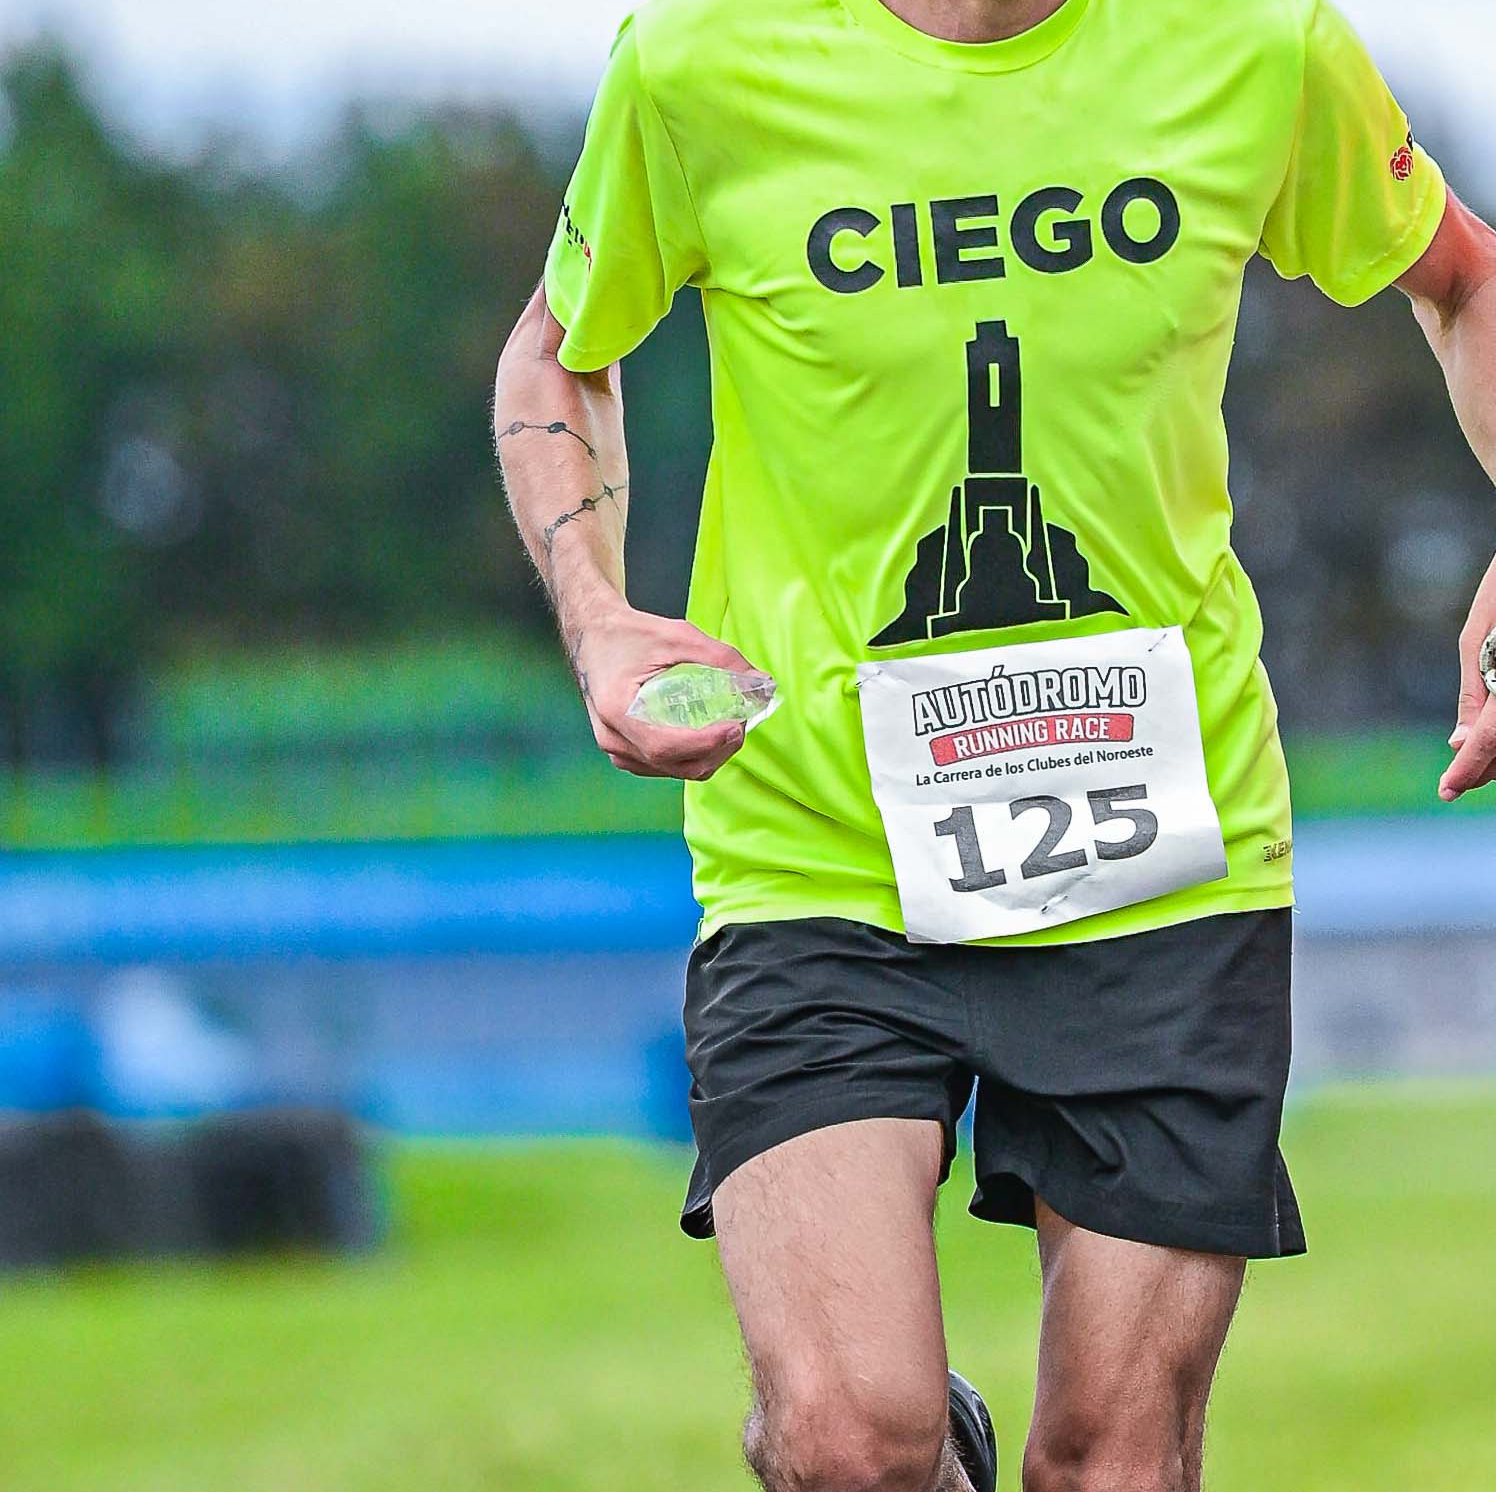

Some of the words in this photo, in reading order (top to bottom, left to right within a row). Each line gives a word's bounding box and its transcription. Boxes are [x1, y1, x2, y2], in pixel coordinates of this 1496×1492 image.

[807, 177, 1180, 293] CIEGO
[912, 664, 1147, 736] AUTÓDROMO
[916, 774, 931, 786] La
[934, 769, 982, 784] Carrera
[985, 764, 1002, 777] de
[1005, 762, 1024, 775] los
[1027, 756, 1071, 771] Clubes
[1073, 751, 1093, 765] del
[1096, 746, 1154, 762] Noroeste
[952, 720, 1048, 759] RUNNING
[1054, 717, 1111, 740] RACE
[934, 783, 1159, 893] 125
